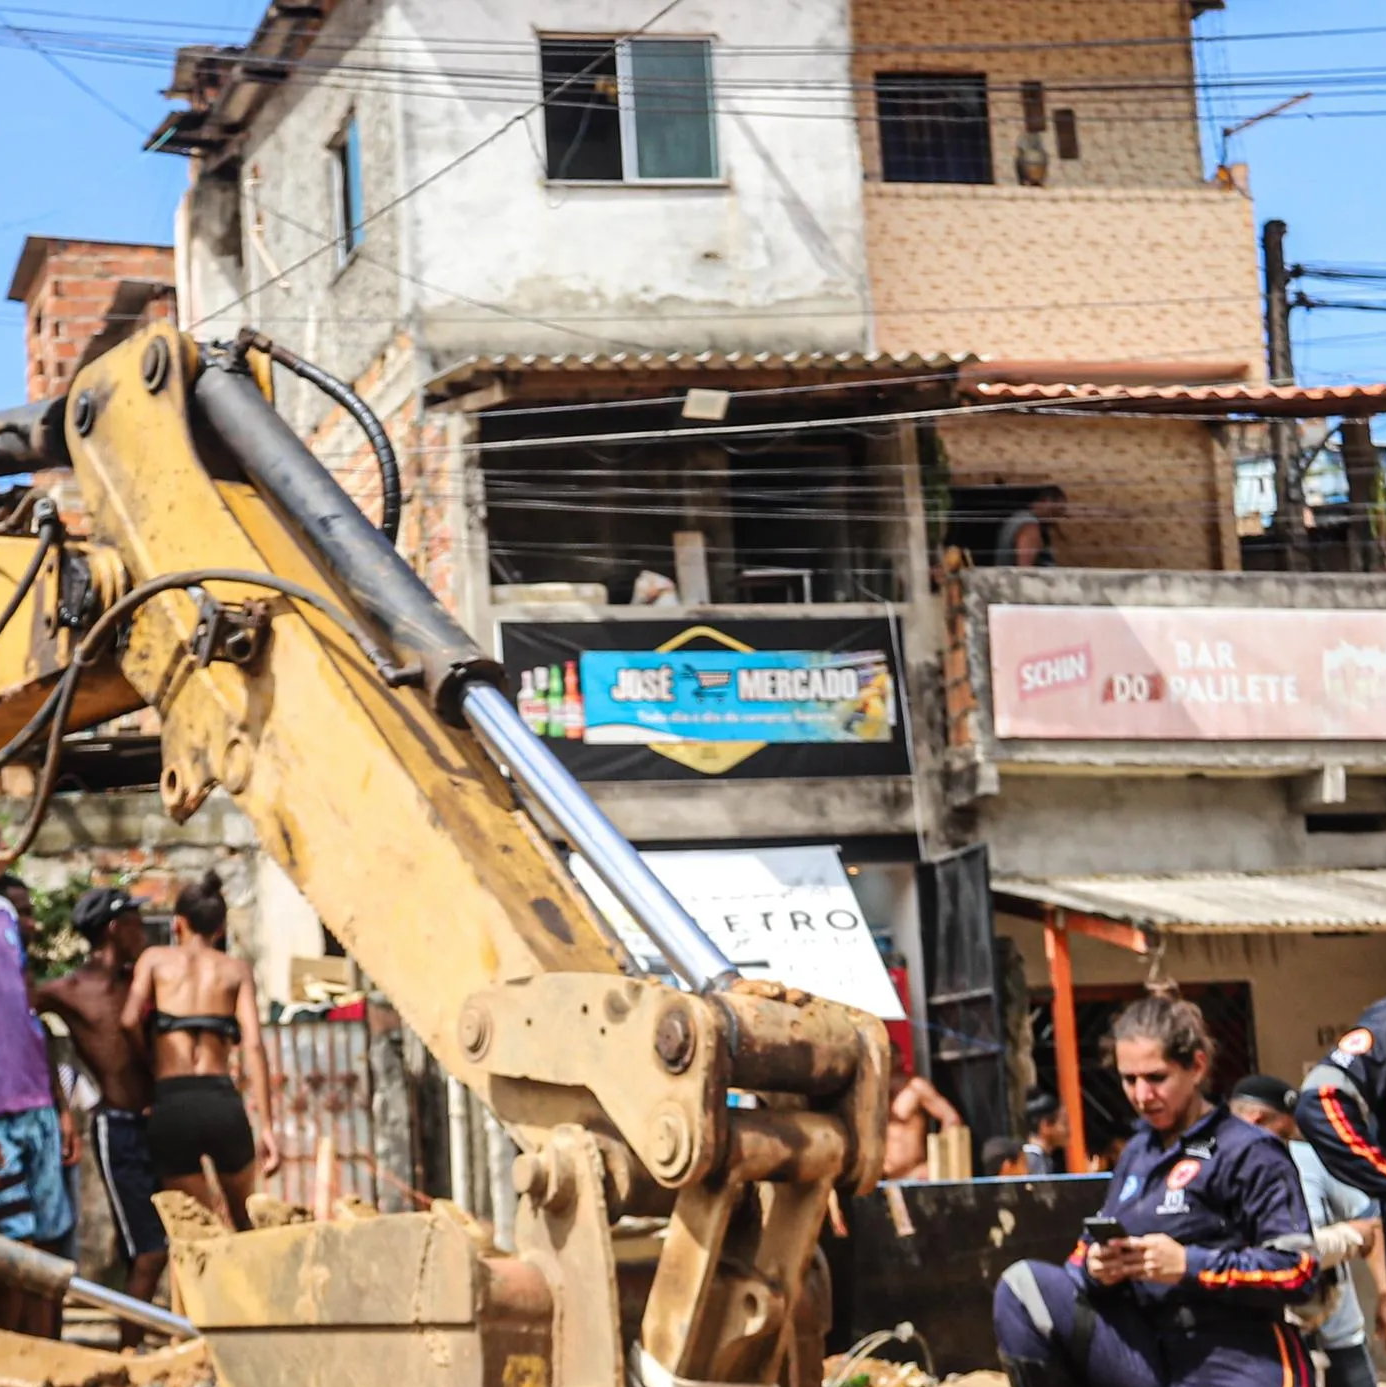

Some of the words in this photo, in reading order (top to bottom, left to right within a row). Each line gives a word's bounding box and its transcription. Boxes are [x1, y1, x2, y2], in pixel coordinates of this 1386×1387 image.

[1175, 640, 1236, 669] BAR
[612, 664, 674, 701] JOSÉ
[738, 668, 859, 702] MERCADO
[1114, 674, 1150, 702] DO
[1169, 673, 1300, 703] PAULETE
